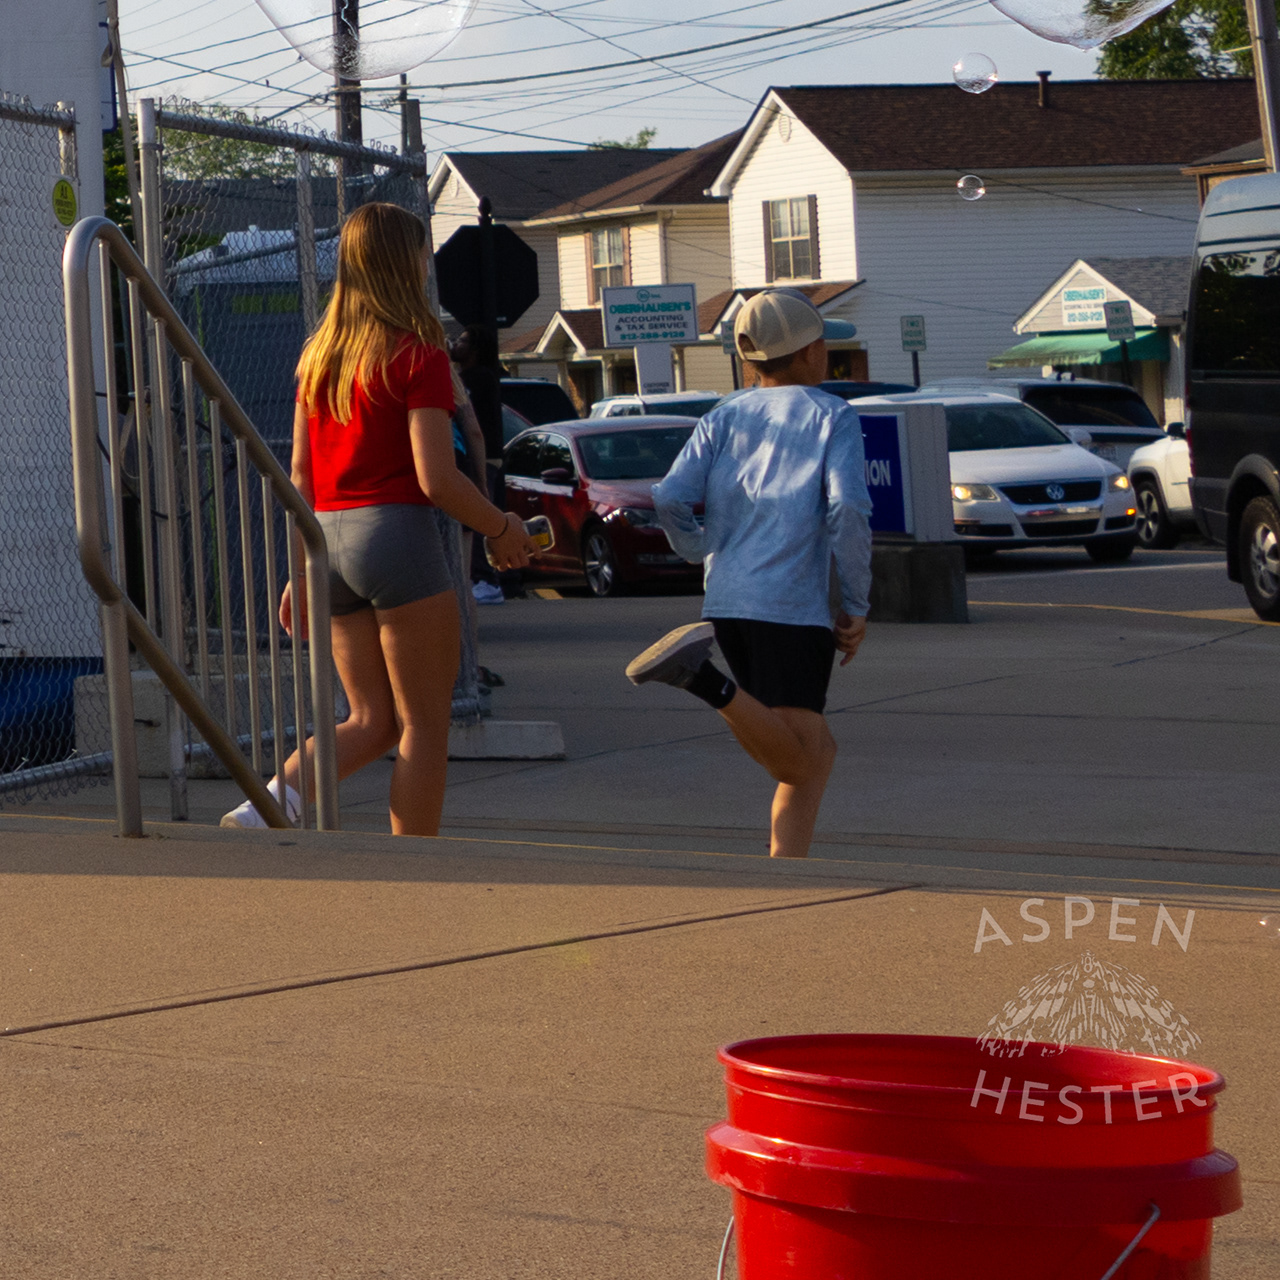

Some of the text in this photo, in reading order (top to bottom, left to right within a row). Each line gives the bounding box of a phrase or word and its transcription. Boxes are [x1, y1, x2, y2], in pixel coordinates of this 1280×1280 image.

[609, 302, 691, 314] OBERHAUSEN'S
[618, 314, 684, 323] ACCOUNTING
[648, 321, 688, 329] SERVICE
[865, 459, 891, 486] ION
